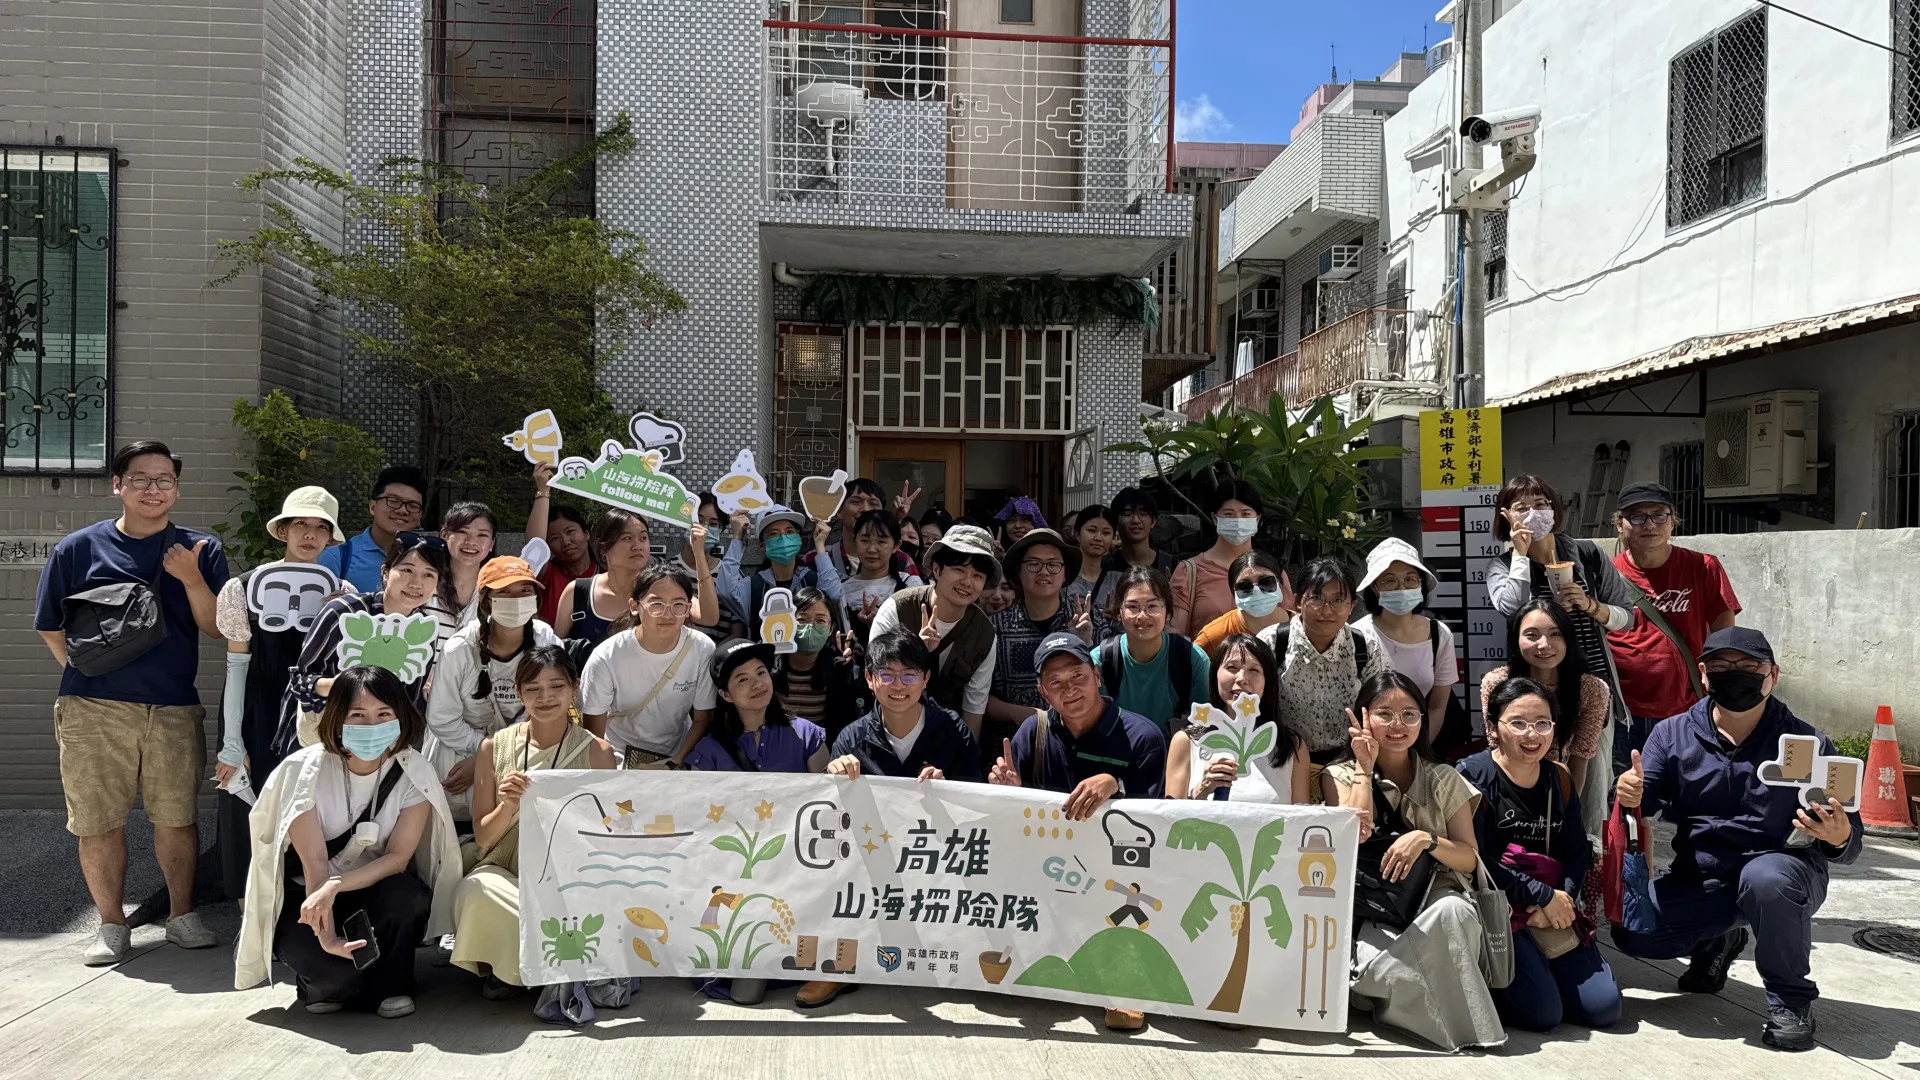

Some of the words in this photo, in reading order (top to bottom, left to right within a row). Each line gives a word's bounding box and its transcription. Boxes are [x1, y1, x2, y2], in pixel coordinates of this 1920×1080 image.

[1438, 411, 1456, 486] 高雄市政府
[1466, 409, 1483, 485] 經濟部水利署
[602, 467, 677, 499] 山海探險隊
[600, 482, 644, 503] follow
[645, 497, 671, 511] me!
[1470, 520, 1490, 531] 150
[0, 541, 52, 559] 7巷14
[1480, 545, 1500, 556] 140
[1471, 571, 1486, 581] 13
[1482, 596, 1493, 606] 12
[1472, 622, 1493, 632] 110
[1483, 647, 1504, 658] 100
[1497, 809, 1564, 836] Everythng
[895, 818, 991, 878] 高雄
[1042, 855, 1097, 895] Go!
[832, 881, 1039, 932] 山海探險隊
[907, 948, 960, 961] 高雄市政府
[906, 960, 959, 974] 青年局
